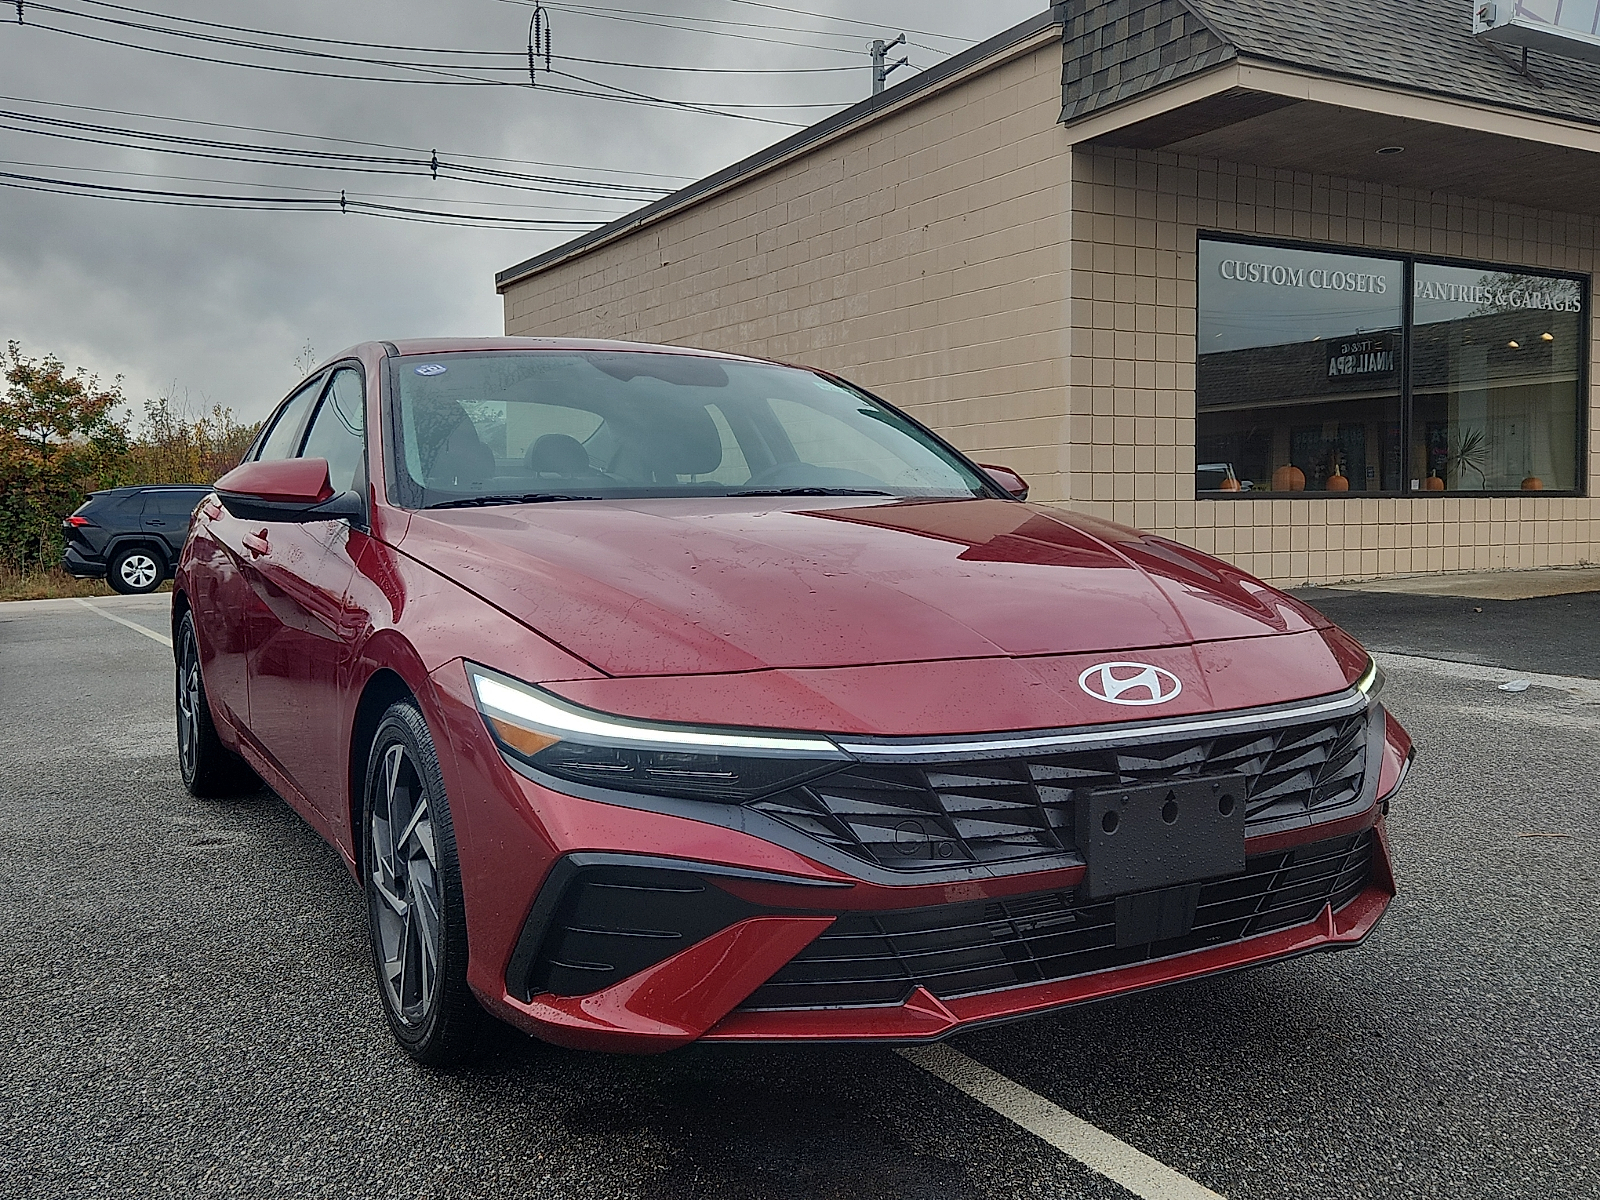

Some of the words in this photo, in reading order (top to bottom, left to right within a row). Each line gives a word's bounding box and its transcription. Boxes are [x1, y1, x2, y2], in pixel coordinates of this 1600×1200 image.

[1220, 259, 1304, 288] CUSTOM
[1309, 269, 1387, 294] CLOSETS
[1413, 279, 1493, 305] PANTRIES
[1495, 289, 1509, 306] &
[1509, 289, 1582, 313] GARAGES
